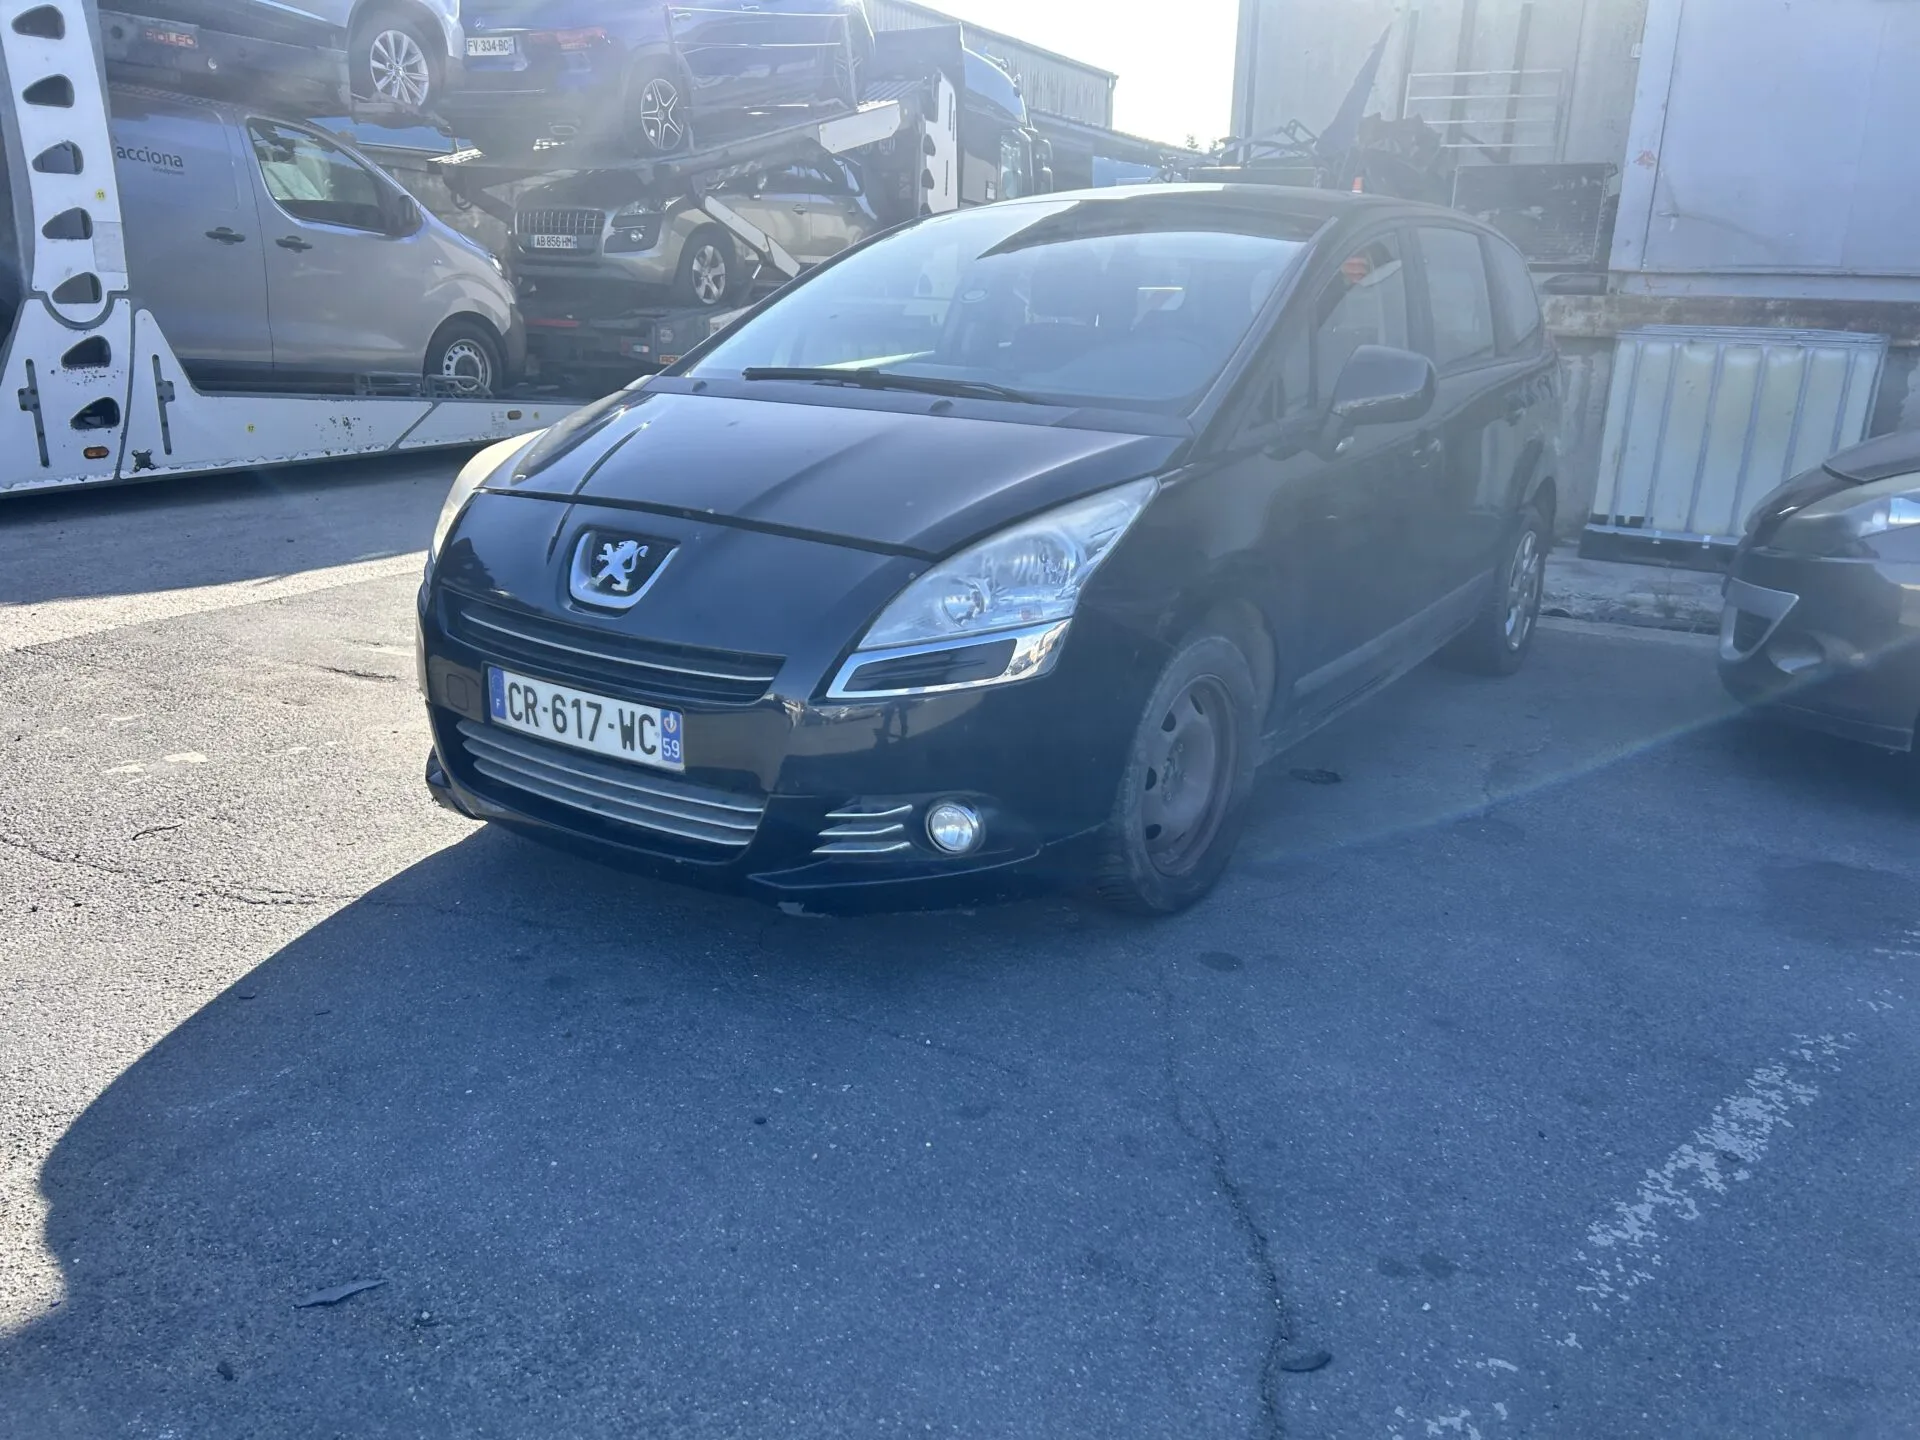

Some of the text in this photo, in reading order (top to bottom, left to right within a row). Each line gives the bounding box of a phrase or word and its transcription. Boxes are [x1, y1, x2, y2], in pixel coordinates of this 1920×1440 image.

[116, 146, 183, 167] acciona
[507, 681, 658, 756] CR-617-WC
[661, 737, 681, 759] 59
